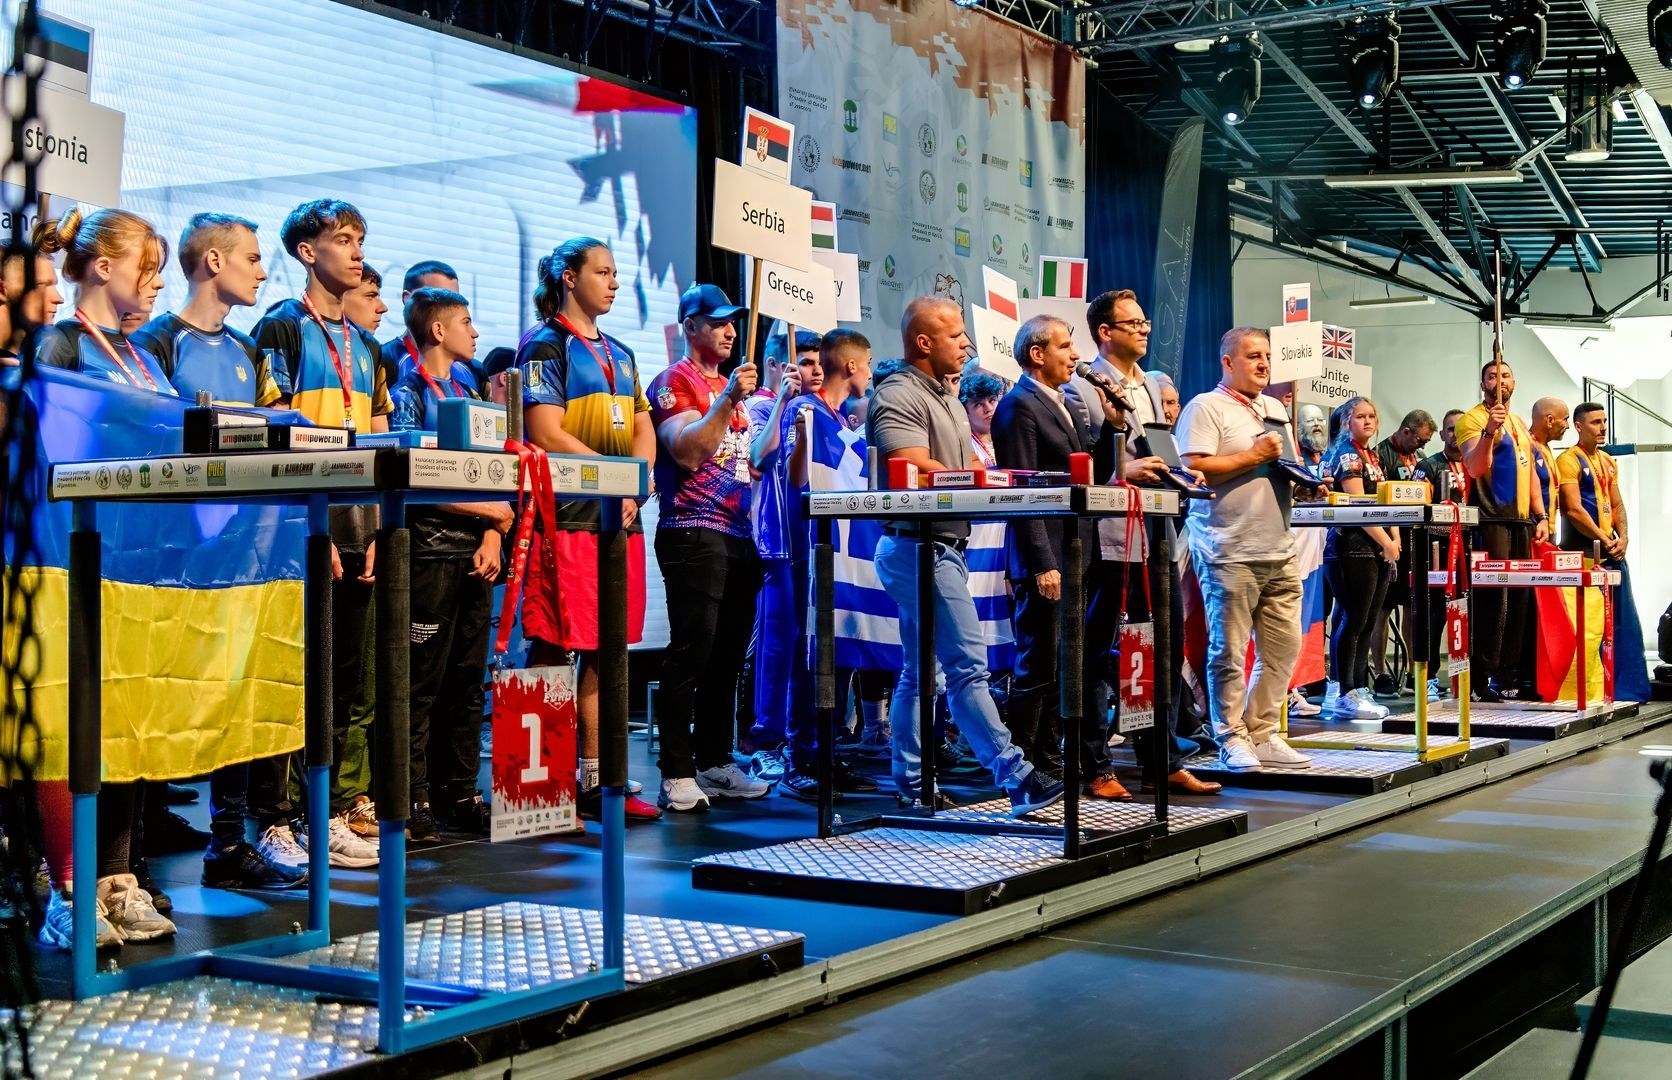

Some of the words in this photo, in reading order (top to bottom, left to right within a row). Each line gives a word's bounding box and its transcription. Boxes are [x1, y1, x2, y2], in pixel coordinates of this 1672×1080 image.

[24, 126, 89, 165] stonia
[742, 201, 785, 235] Serbia
[767, 271, 814, 304] Greece
[992, 335, 1012, 358] Pola
[1281, 344, 1313, 361] Slovakia
[1311, 379, 1358, 398] Kingdom
[1320, 367, 1350, 383] Unite
[1453, 619, 1462, 651] 3
[1130, 651, 1144, 696] 2
[520, 713, 549, 784] 1
